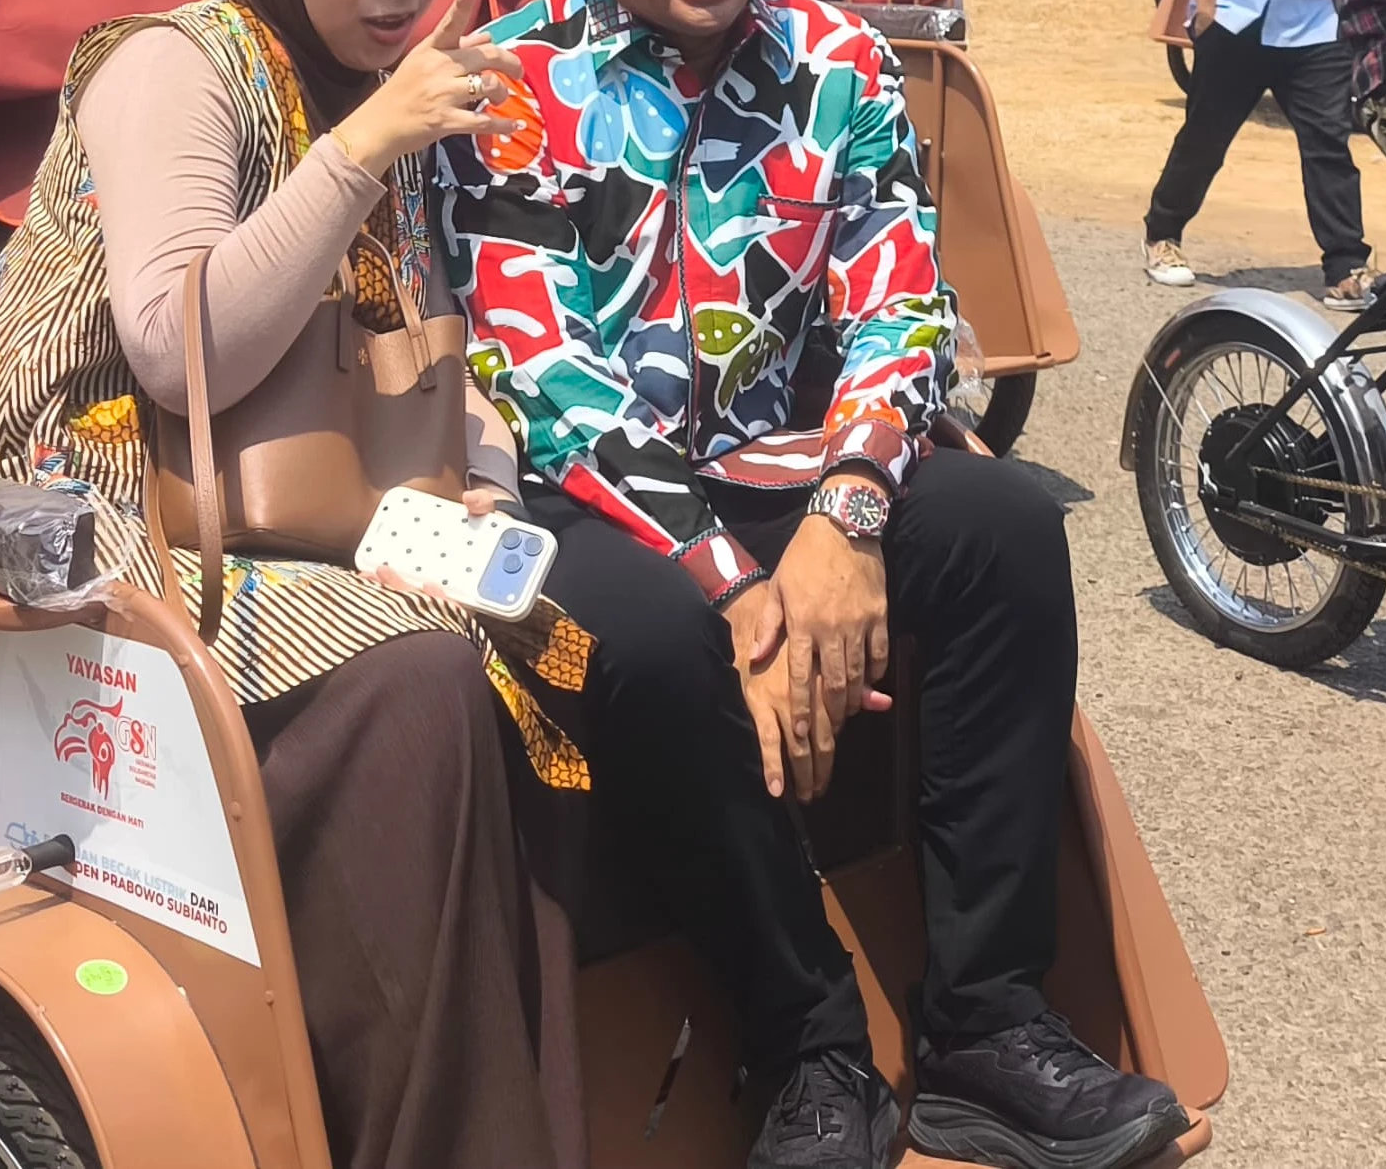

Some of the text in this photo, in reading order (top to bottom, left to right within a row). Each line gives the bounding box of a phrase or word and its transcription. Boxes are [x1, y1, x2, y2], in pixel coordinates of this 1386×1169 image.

[65, 653, 137, 693] YAYASAN
[115, 715, 157, 761] GSN
[127, 815, 144, 829] HATI
[101, 854, 141, 881] BECAK
[144, 872, 187, 900] LISTRIK
[189, 891, 219, 916] DARI
[102, 869, 164, 907] PRABOWO
[167, 899, 228, 934] SUBIANTO
